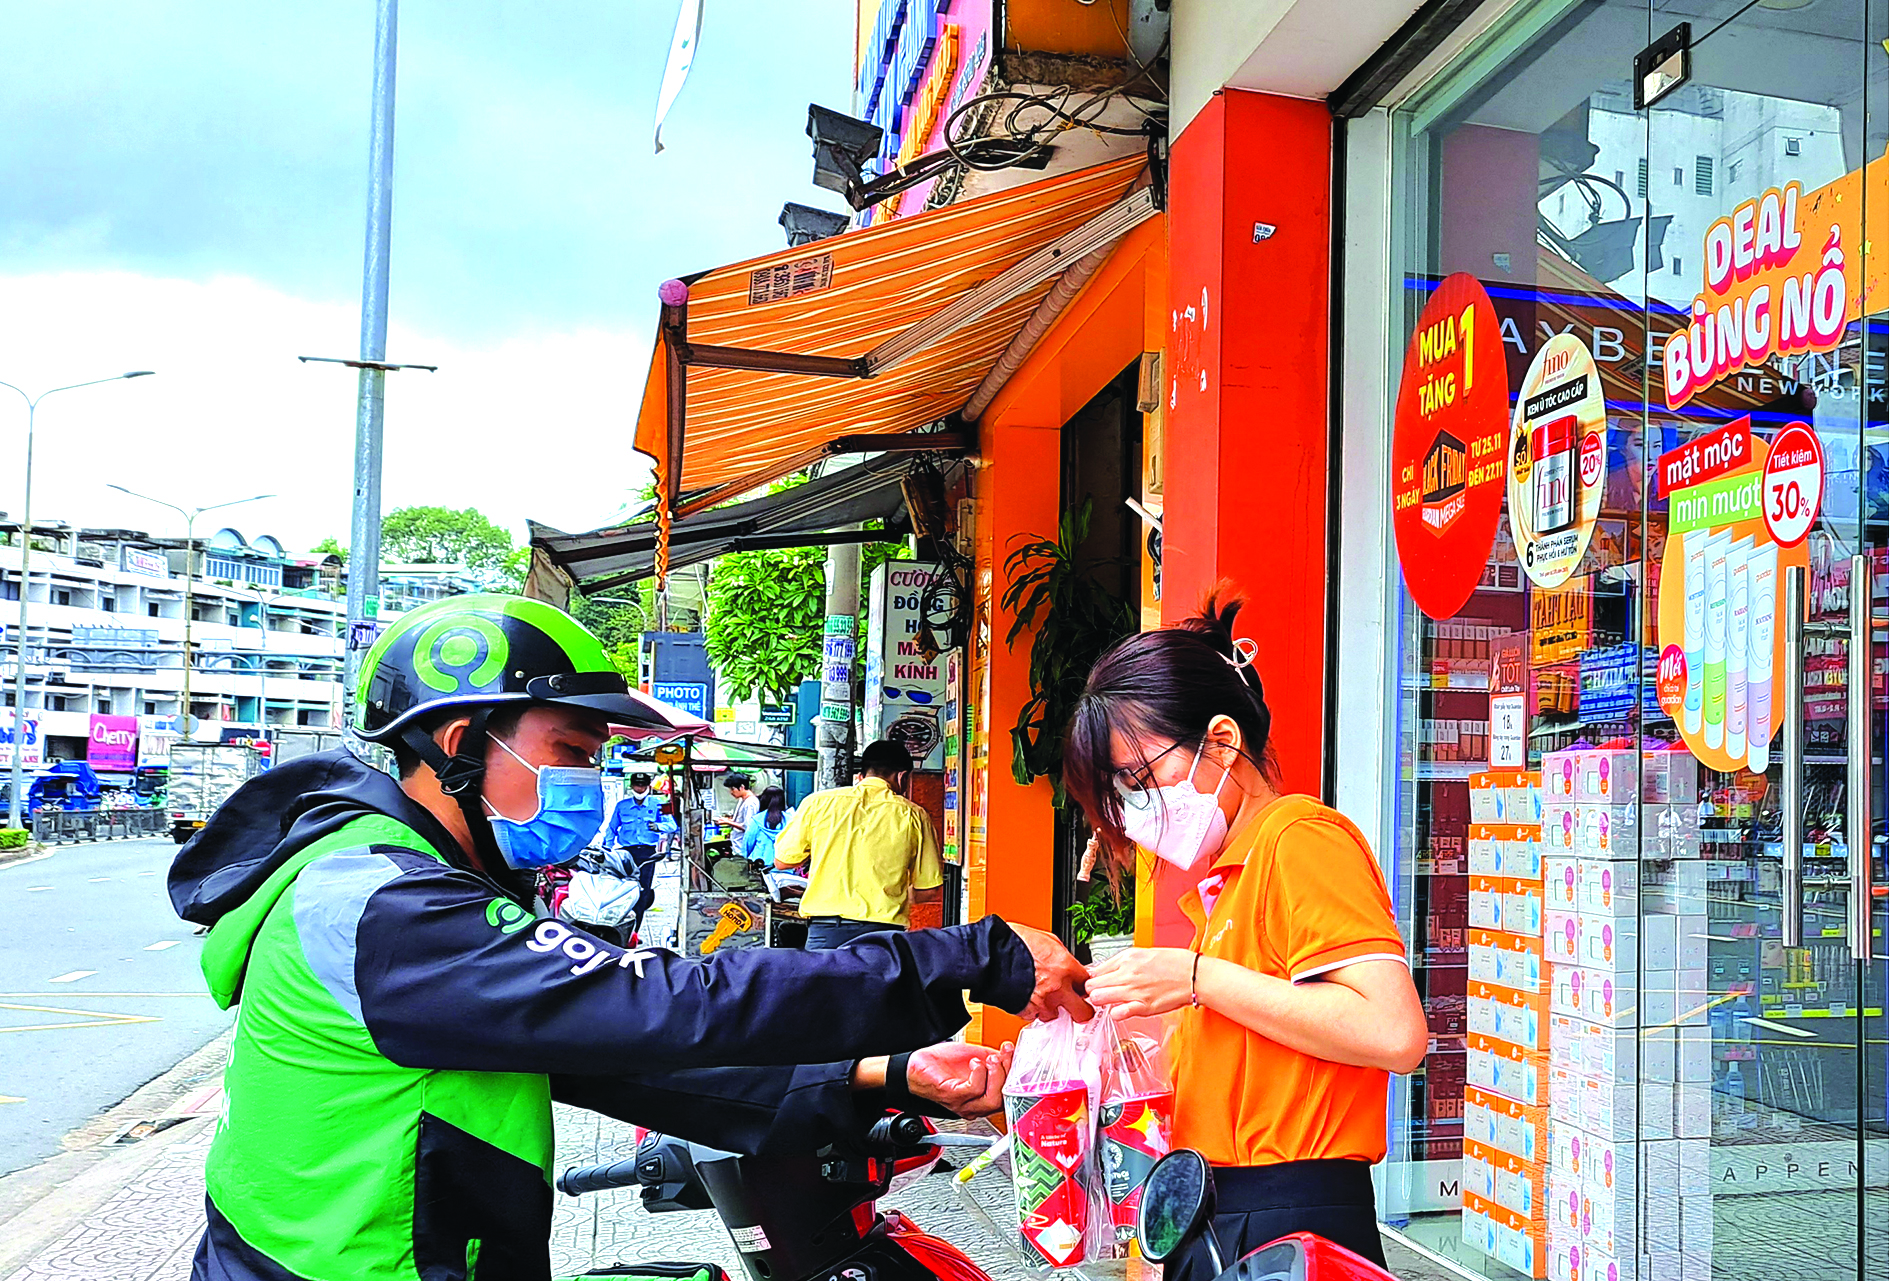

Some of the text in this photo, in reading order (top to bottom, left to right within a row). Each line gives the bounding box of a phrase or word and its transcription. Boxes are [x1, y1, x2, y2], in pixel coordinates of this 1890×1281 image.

[1706, 187, 1802, 290] DEAL
[1666, 223, 1846, 399] BÙNG NỔ
[1419, 302, 1475, 398] MUA 1
[1540, 347, 1569, 388] fino
[1418, 371, 1456, 421] TẶNG
[1738, 375, 1799, 396] NEW
[1482, 432, 1502, 455] 25.11
[1667, 432, 1743, 486] mặt mộc
[1774, 449, 1813, 469] Tiết kiệm
[1468, 461, 1485, 488] ĐẾN
[1396, 495, 1402, 511] 3
[1676, 476, 1762, 527] mịn mượt
[1771, 480, 1811, 523] 30%
[1526, 541, 1534, 568] 6
[894, 590, 945, 612] ĐỒG
[894, 661, 938, 680] KÍNH
[1660, 651, 1683, 684] Mới
[657, 686, 700, 699] PHOTO
[93, 722, 136, 752] Cherry
[525, 920, 658, 979] gojk
[1040, 1139, 1067, 1148] Nature
[1721, 1160, 1859, 1183] APPEN
